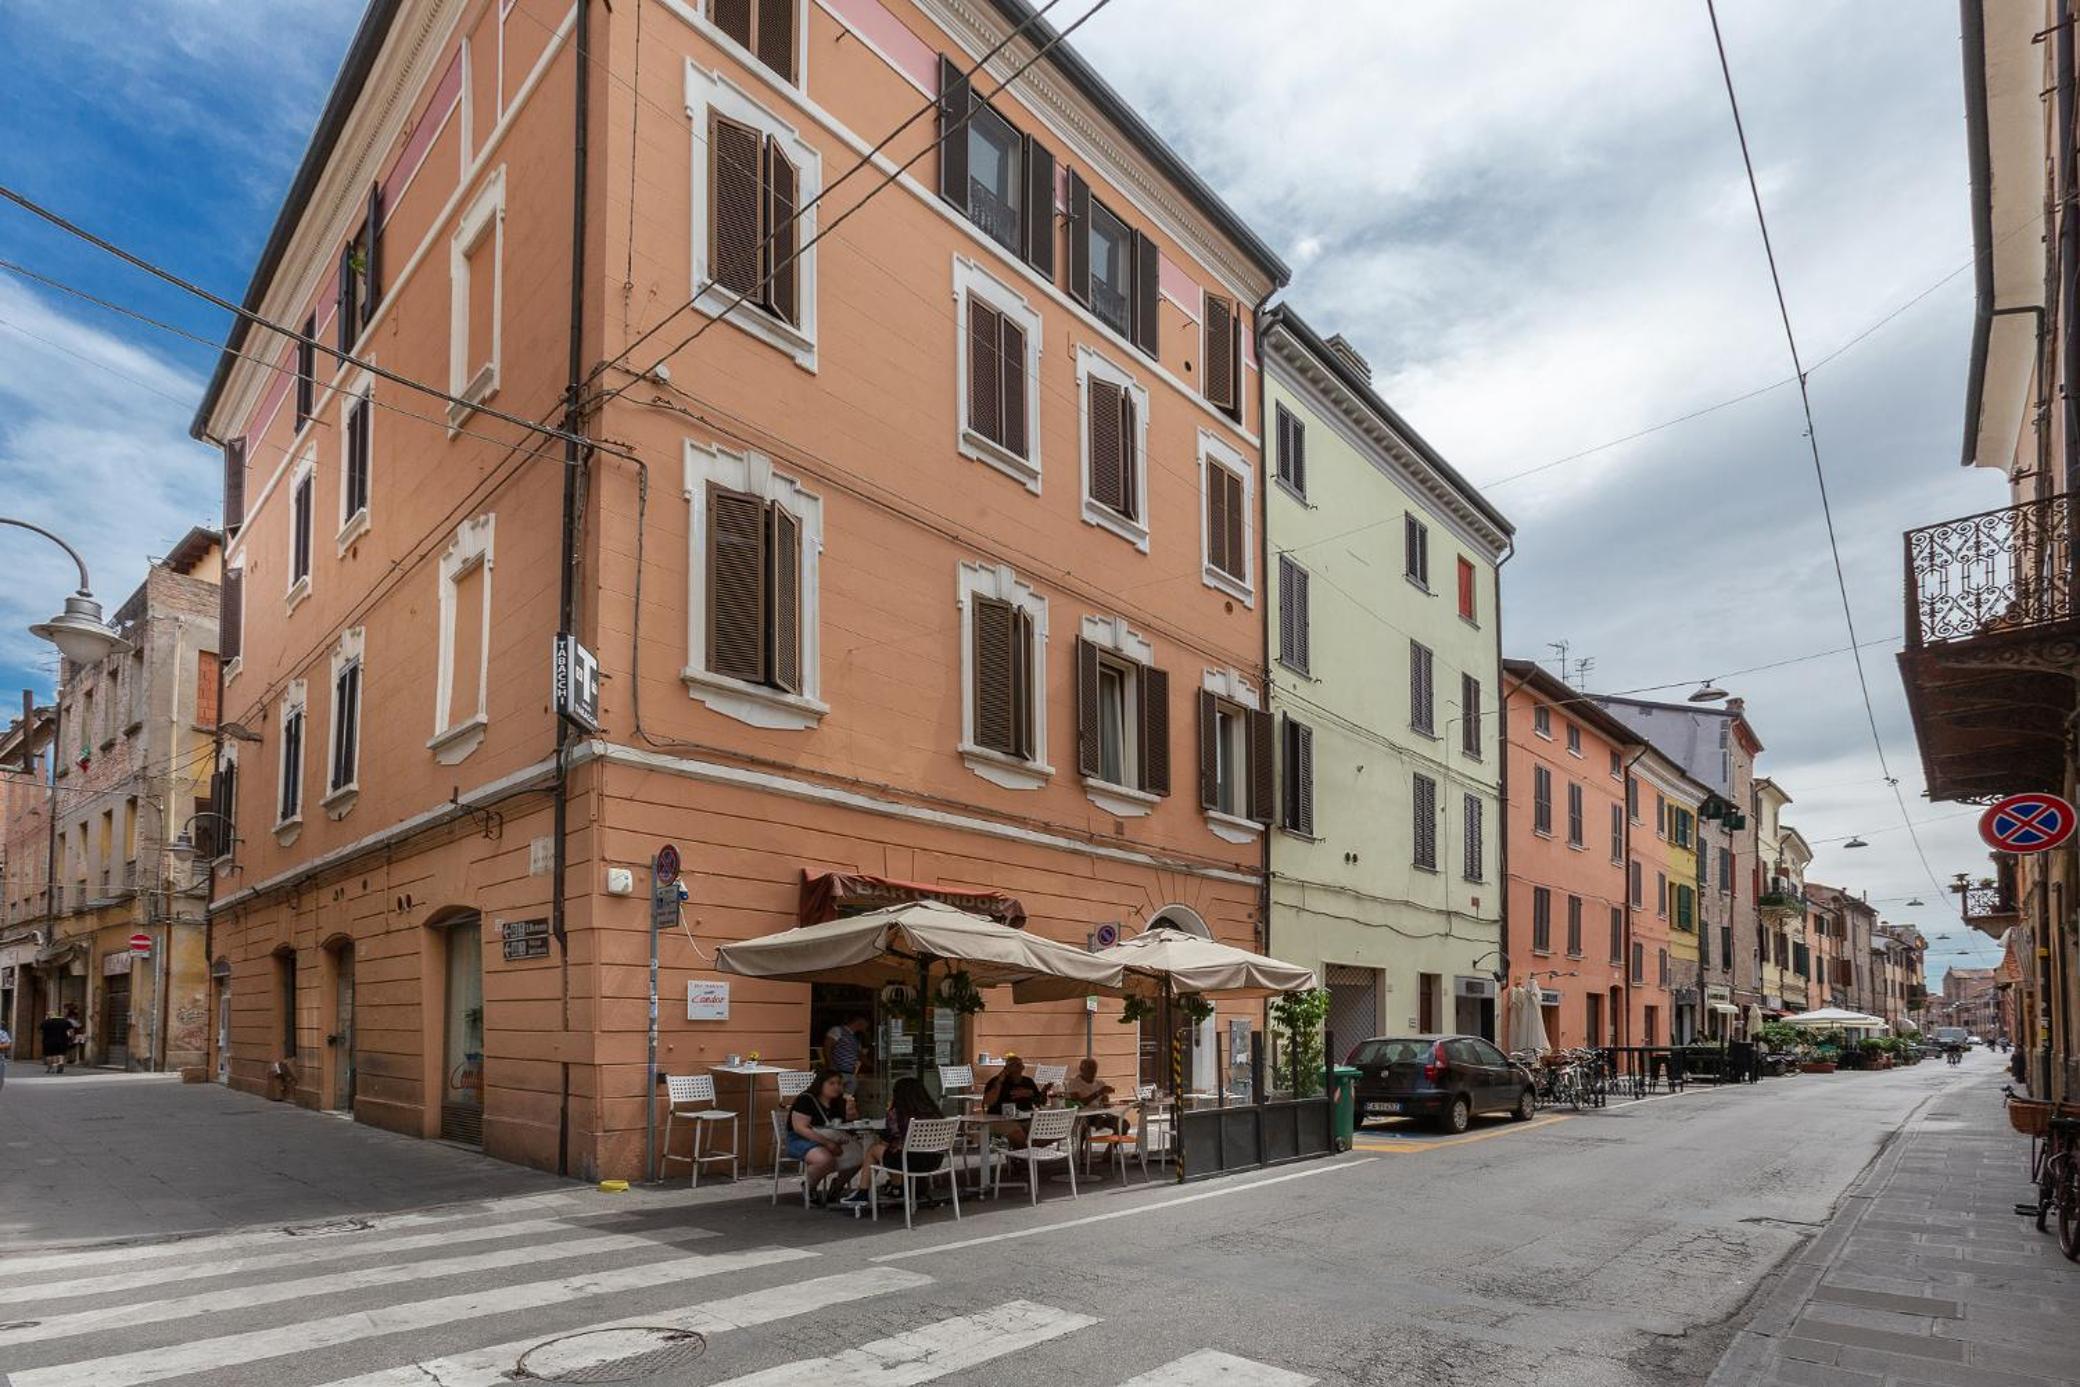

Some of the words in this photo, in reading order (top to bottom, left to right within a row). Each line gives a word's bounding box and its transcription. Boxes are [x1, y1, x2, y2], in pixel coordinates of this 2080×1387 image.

[558, 640, 567, 705] TABACCHI
[577, 643, 597, 703] T
[856, 881, 907, 898] BAR
